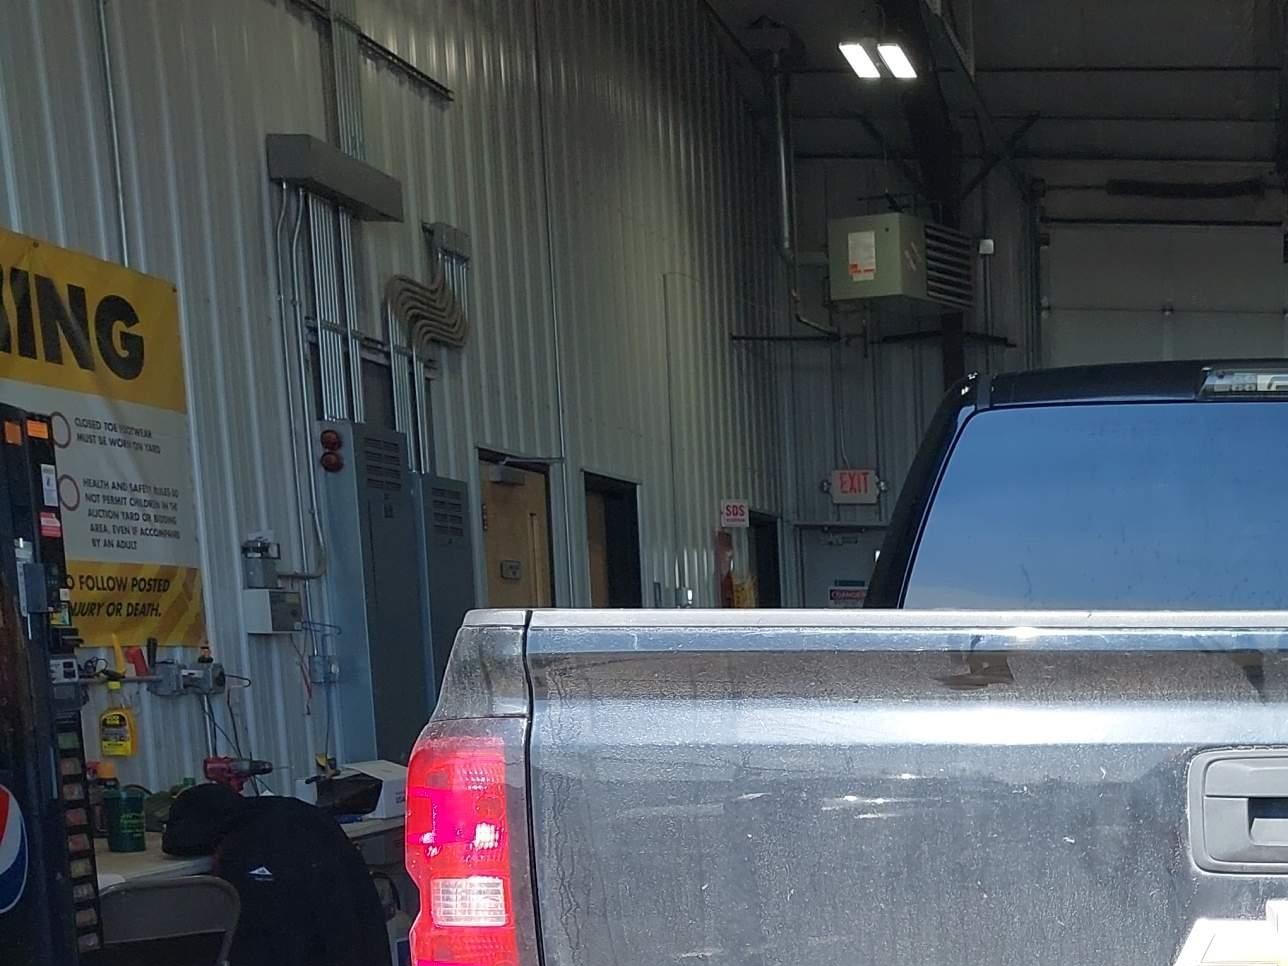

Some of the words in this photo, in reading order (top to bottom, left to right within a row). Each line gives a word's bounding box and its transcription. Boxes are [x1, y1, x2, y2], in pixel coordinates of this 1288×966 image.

[0, 263, 145, 380] ING
[74, 417, 101, 430] CLOSED
[103, 422, 118, 433] TOE
[77, 432, 96, 444] MUST
[98, 435, 107, 446] BE
[144, 443, 161, 454] YARD
[82, 477, 109, 490] HEALTH
[111, 480, 128, 492] AND
[129, 482, 152, 495] SAFETY
[839, 472, 869, 494] EXIT
[85, 492, 101, 504] NOT
[102, 494, 127, 506] PERMIT
[129, 497, 160, 509] CHILDREN
[87, 508, 119, 520] AUCTION
[121, 511, 140, 521] YARD
[141, 512, 152, 522] OR
[726, 504, 746, 517] SDS
[112, 524, 130, 536] EVEN
[131, 526, 139, 536] IF
[91, 538, 101, 549] BY
[103, 538, 114, 549] AN
[116, 539, 138, 550] ADULT
[65, 574, 75, 590] O
[79, 575, 128, 593] FOLLOW
[131, 576, 170, 593] POSTED
[71, 601, 104, 617] NJURY
[106, 602, 123, 617] OR
[126, 602, 162, 617] DEATH.
